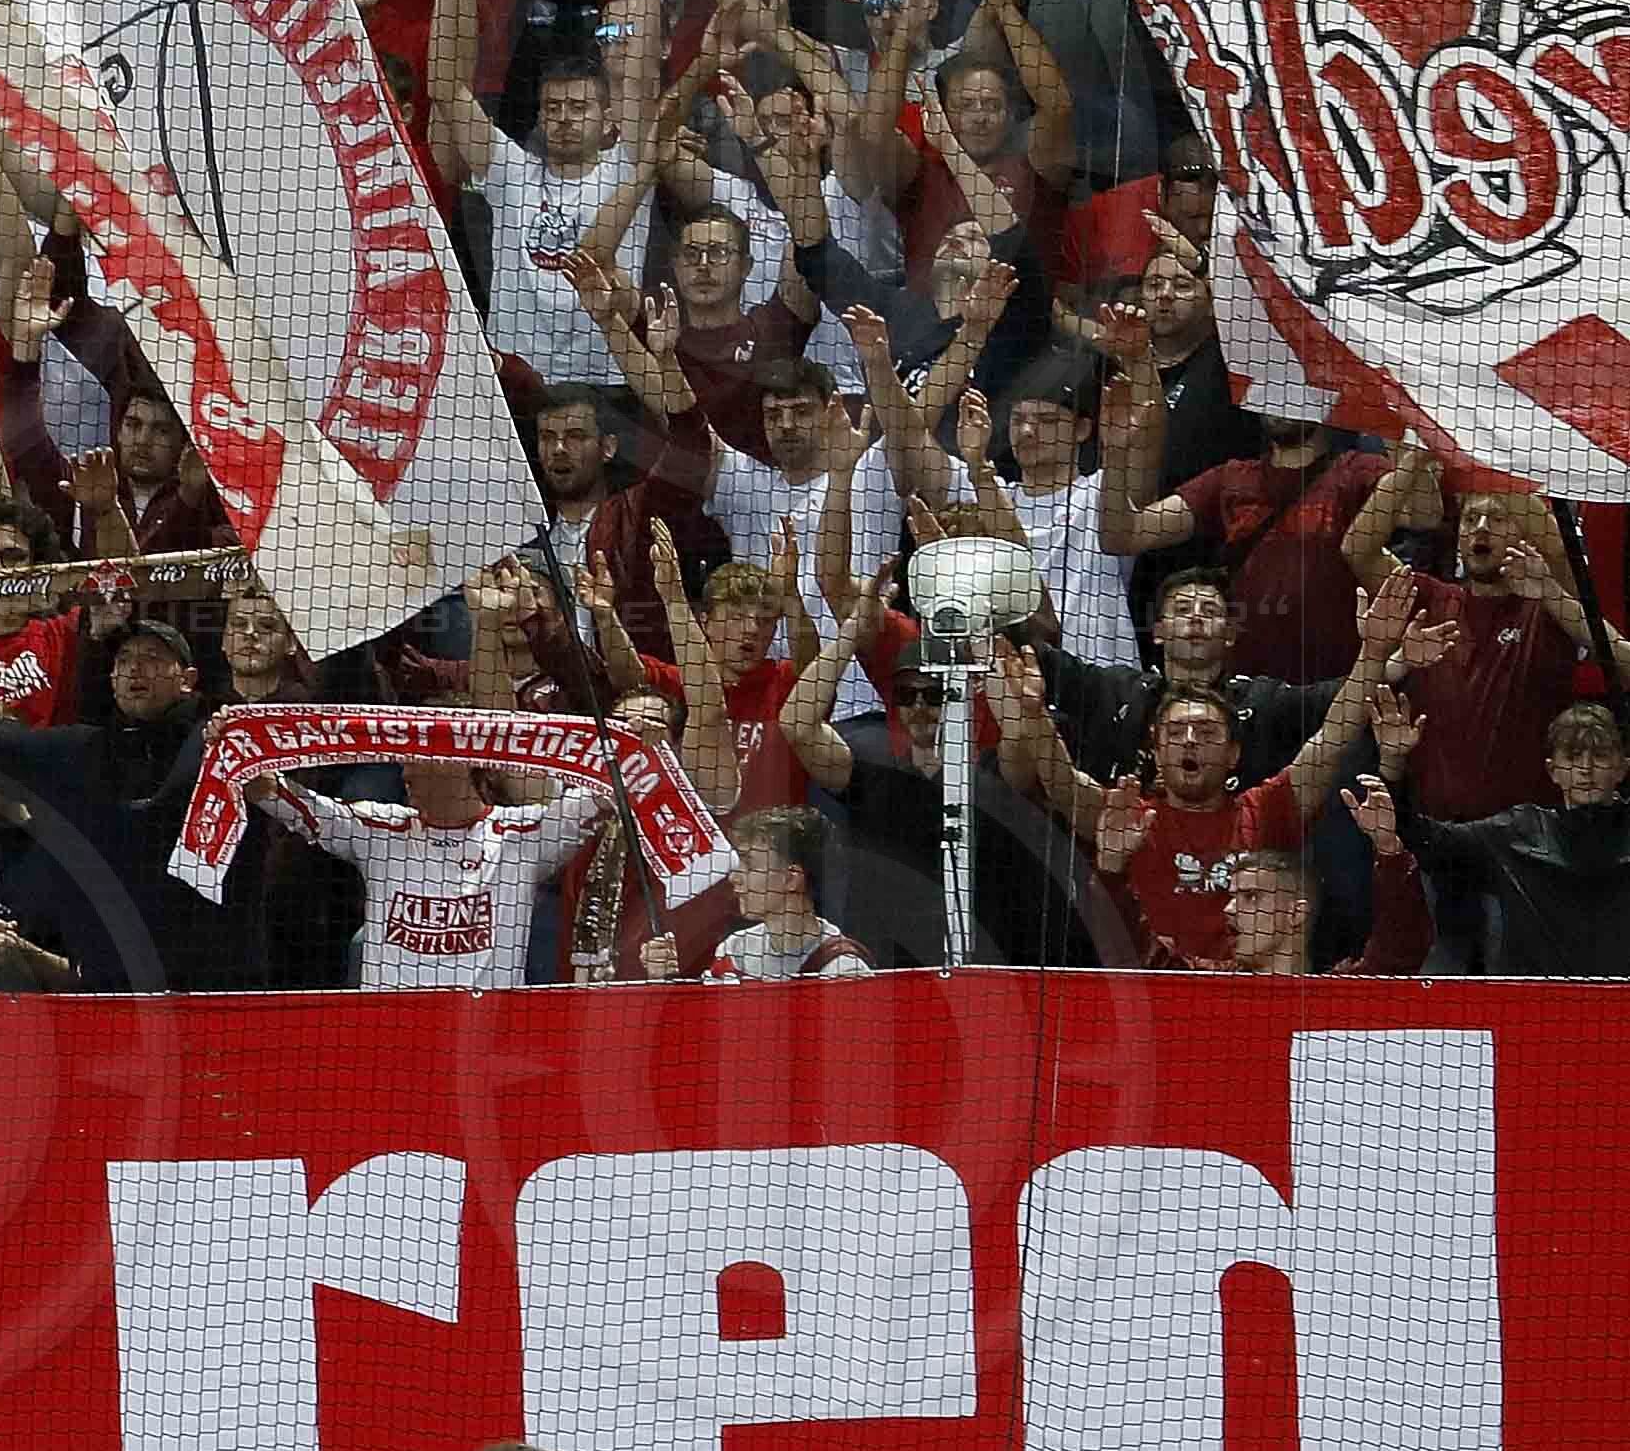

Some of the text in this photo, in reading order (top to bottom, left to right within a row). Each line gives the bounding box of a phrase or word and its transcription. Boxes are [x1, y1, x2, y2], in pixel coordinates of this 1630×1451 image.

[265, 718, 353, 751] GAK
[366, 718, 432, 749] IST
[390, 893, 491, 928] KLEINE
